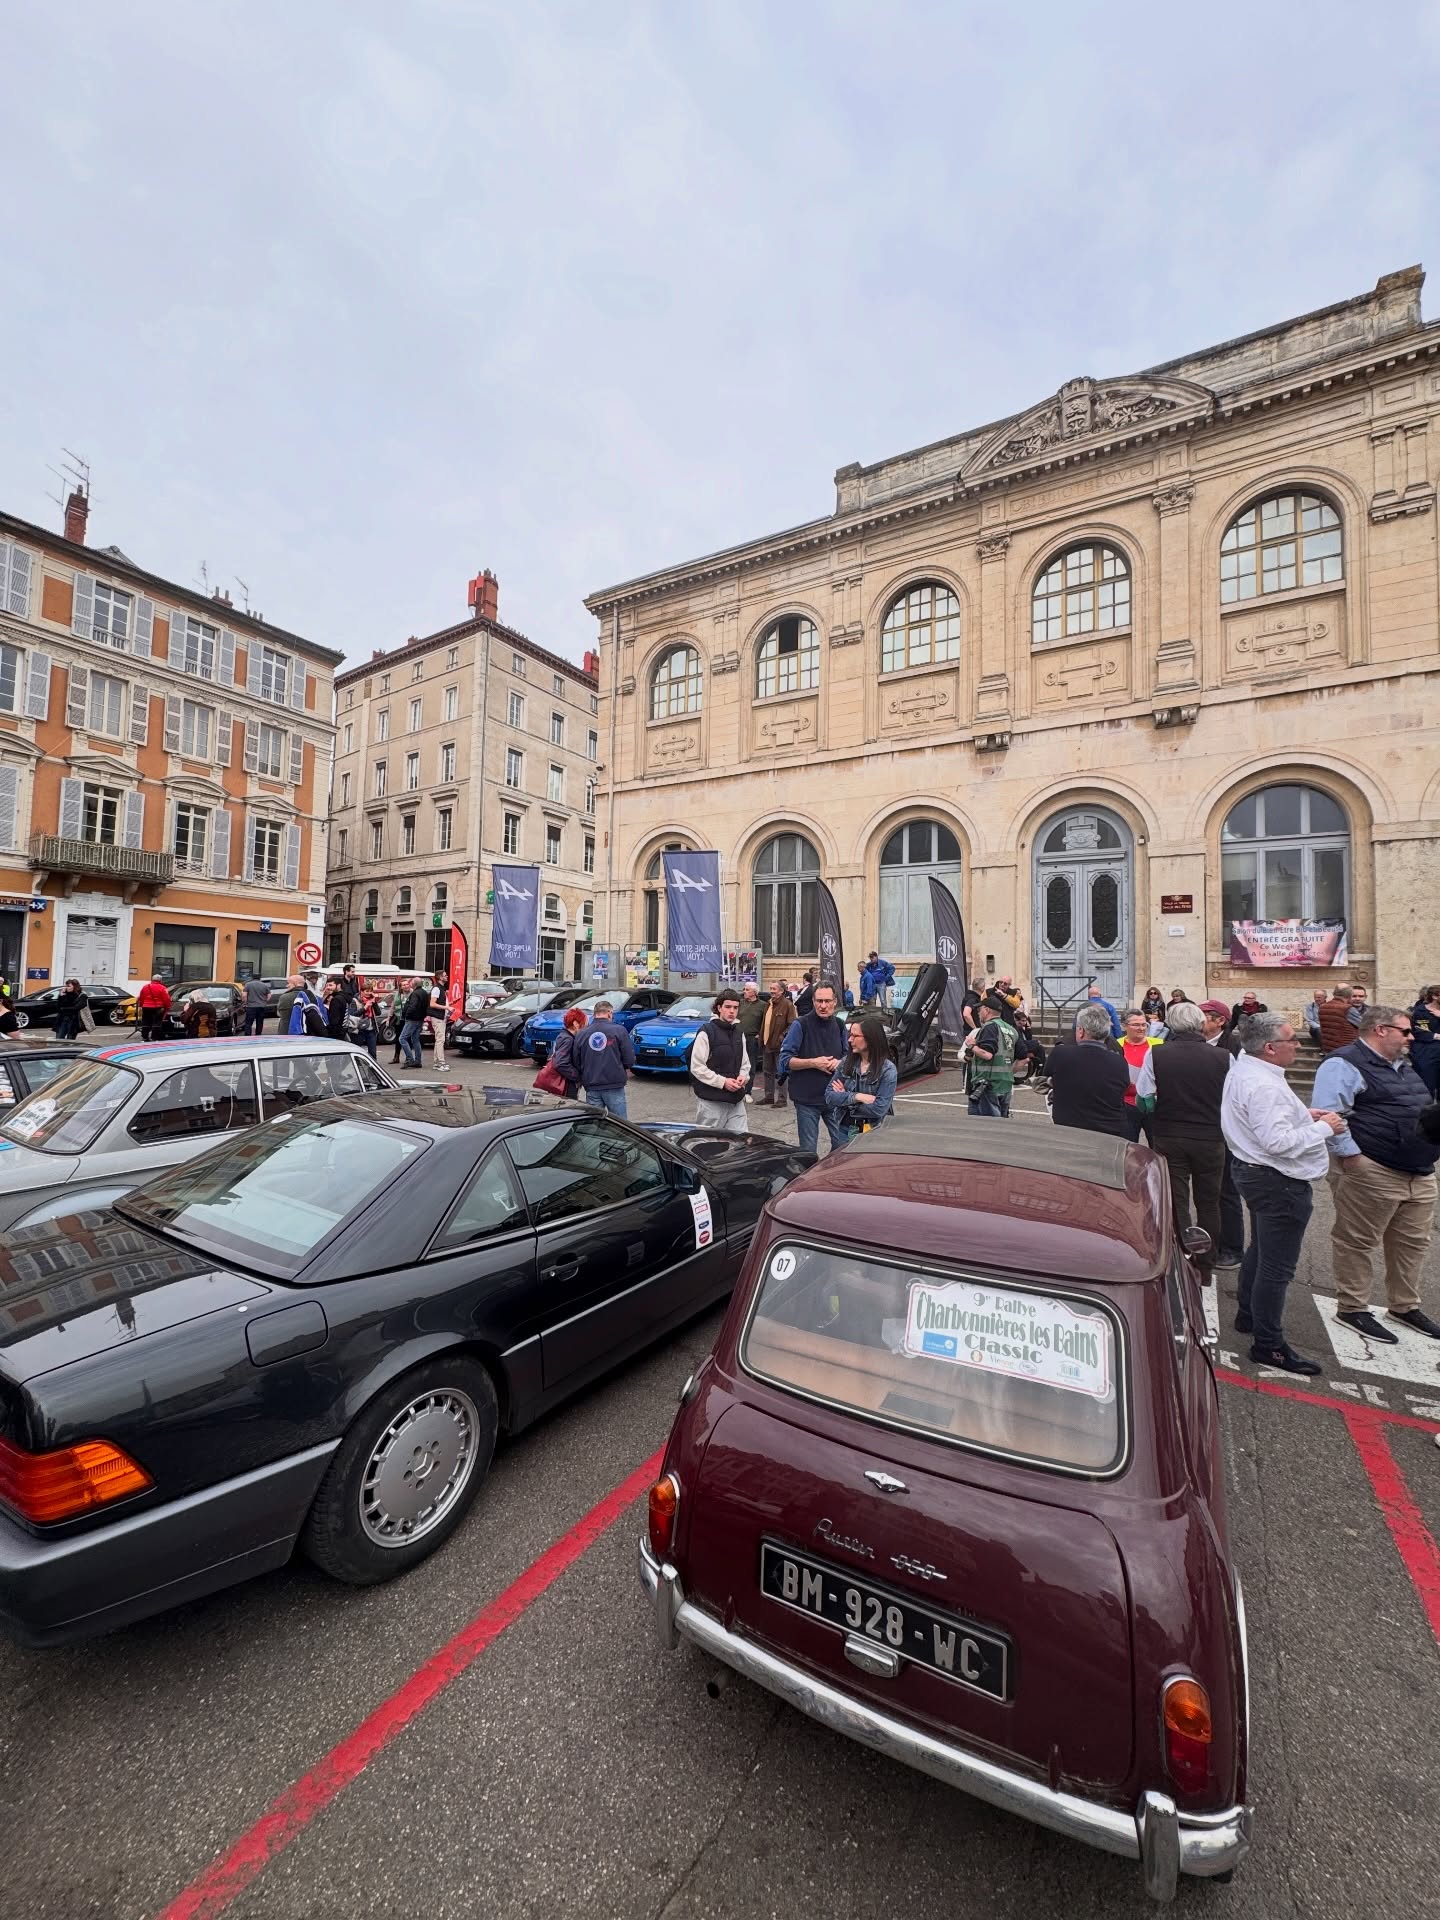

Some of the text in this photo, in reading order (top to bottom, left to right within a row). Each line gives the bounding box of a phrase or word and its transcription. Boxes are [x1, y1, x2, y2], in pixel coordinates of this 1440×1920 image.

[1281, 935, 1325, 943] GRATUITE
[776, 1258, 791, 1273] 07
[995, 1295, 1037, 1318] Rallye
[916, 1291, 1099, 1369] Charbonnières les Bains
[964, 1333, 1043, 1364] Classic
[813, 1518, 875, 1560] Austin
